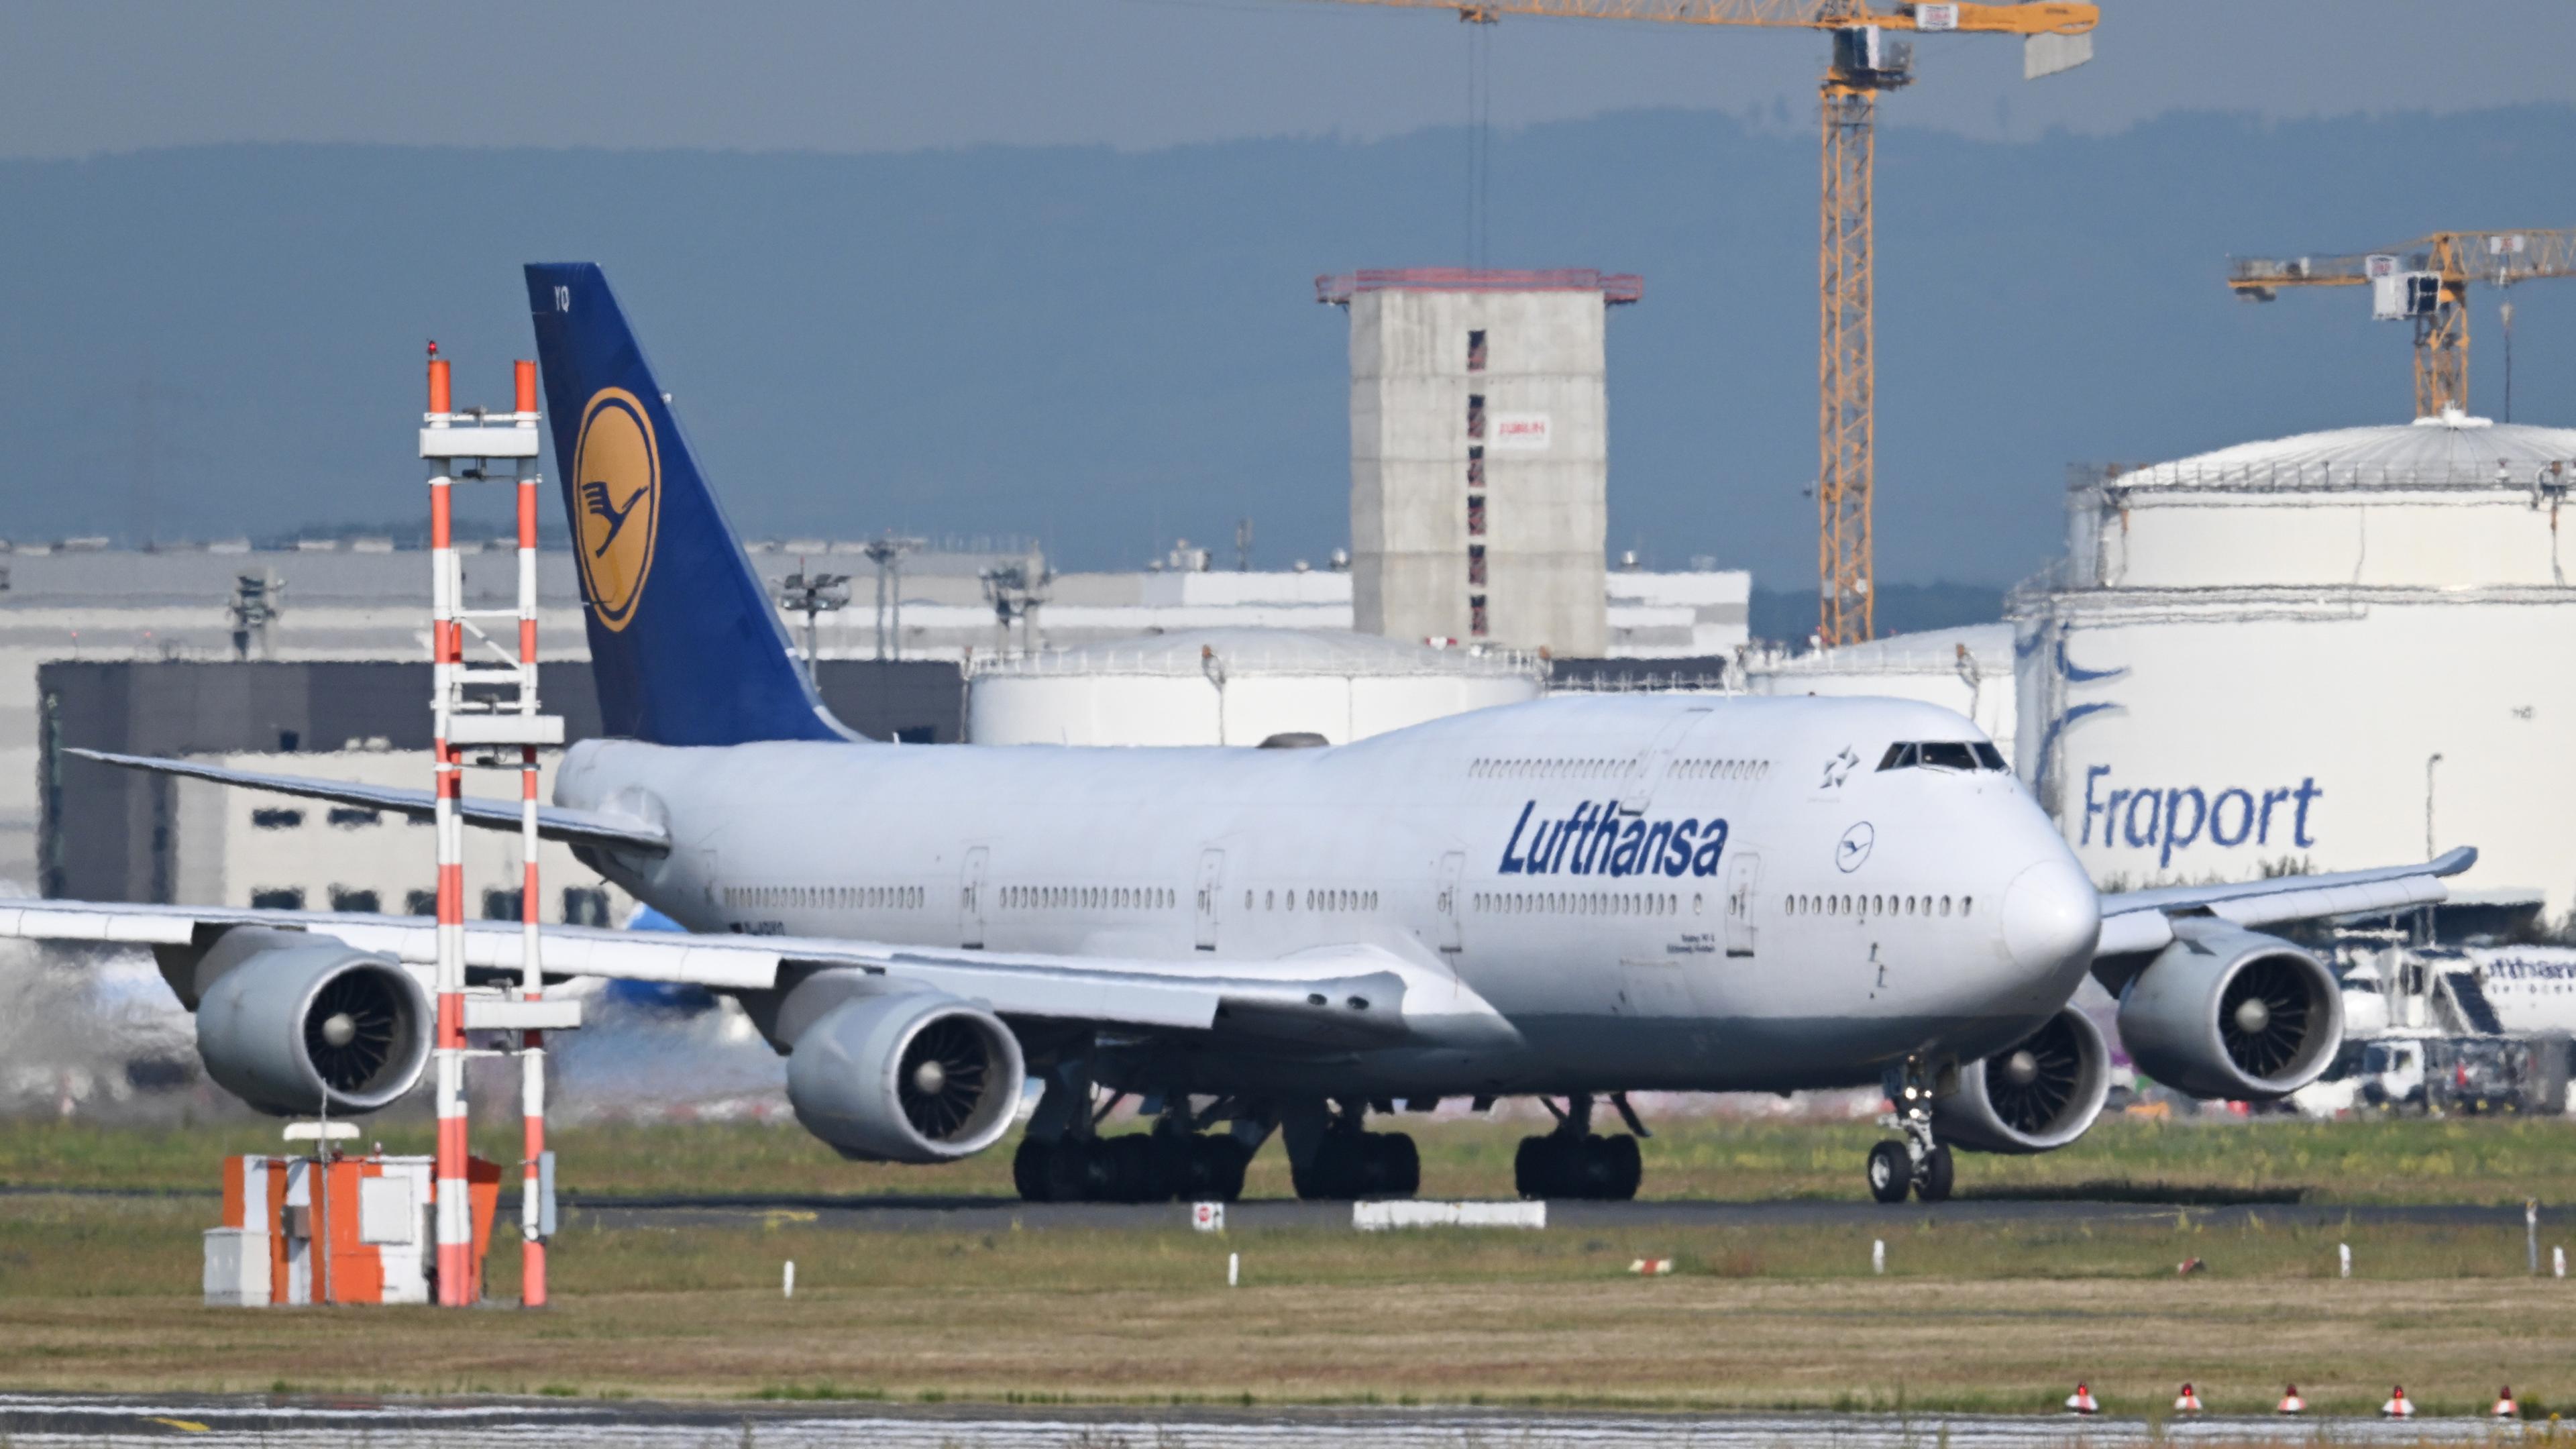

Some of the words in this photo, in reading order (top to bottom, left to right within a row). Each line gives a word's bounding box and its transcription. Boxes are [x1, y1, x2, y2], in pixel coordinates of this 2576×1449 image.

[554, 285, 570, 313] YQ
[1498, 799, 1729, 877] Lufthansa
[2080, 764, 2322, 868] Fraport
